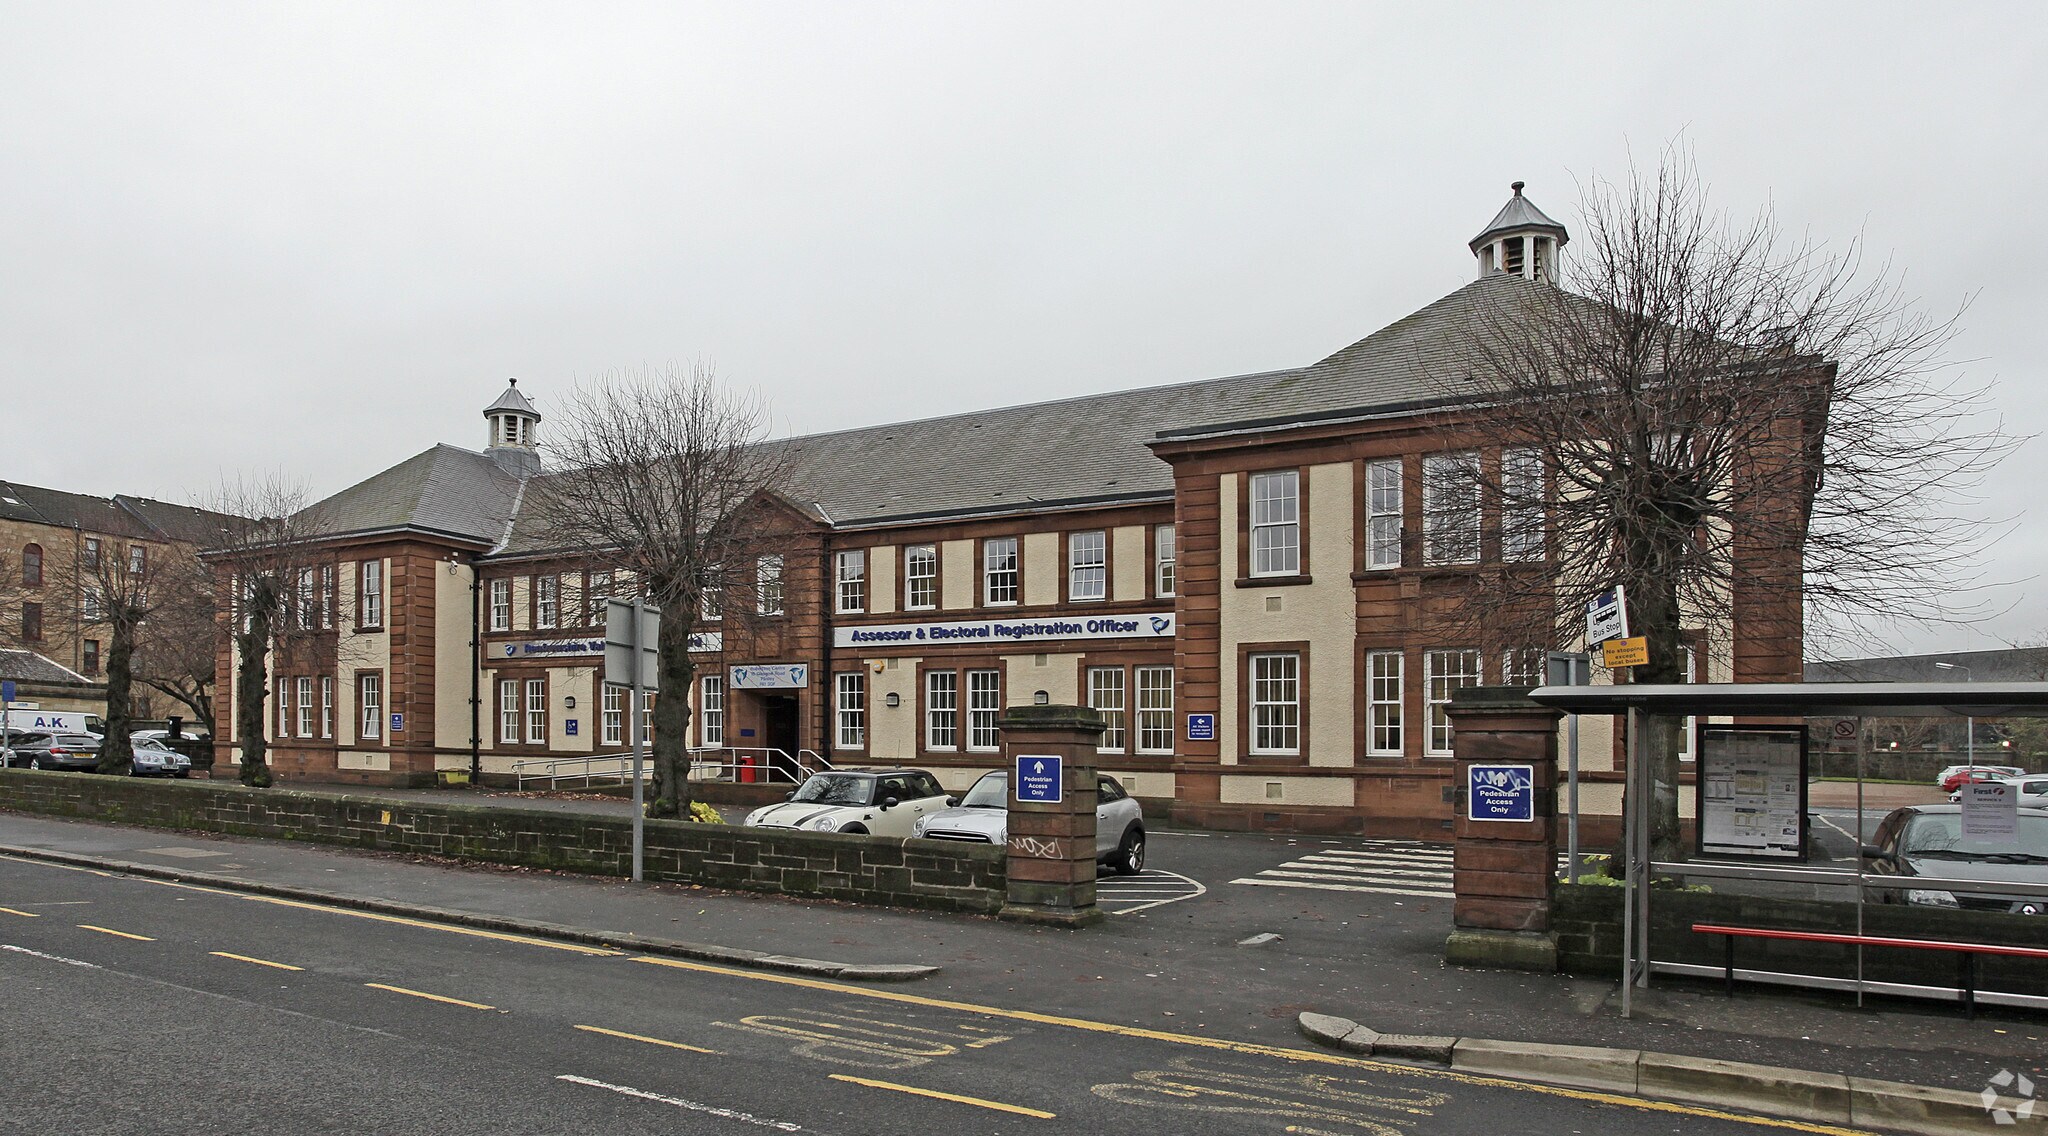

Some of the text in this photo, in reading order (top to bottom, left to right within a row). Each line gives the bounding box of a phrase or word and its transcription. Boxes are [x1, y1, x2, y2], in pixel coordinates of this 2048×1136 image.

[851, 619, 1139, 642] Assessor & Electoral Registration Officer
[1592, 628, 1605, 638] Bus
[1605, 622, 1620, 633] Stop
[34, 716, 68, 728] A.K.
[1023, 775, 1053, 783] Pedestrian
[1031, 789, 1045, 797] Only
[1490, 805, 1509, 814] Only
